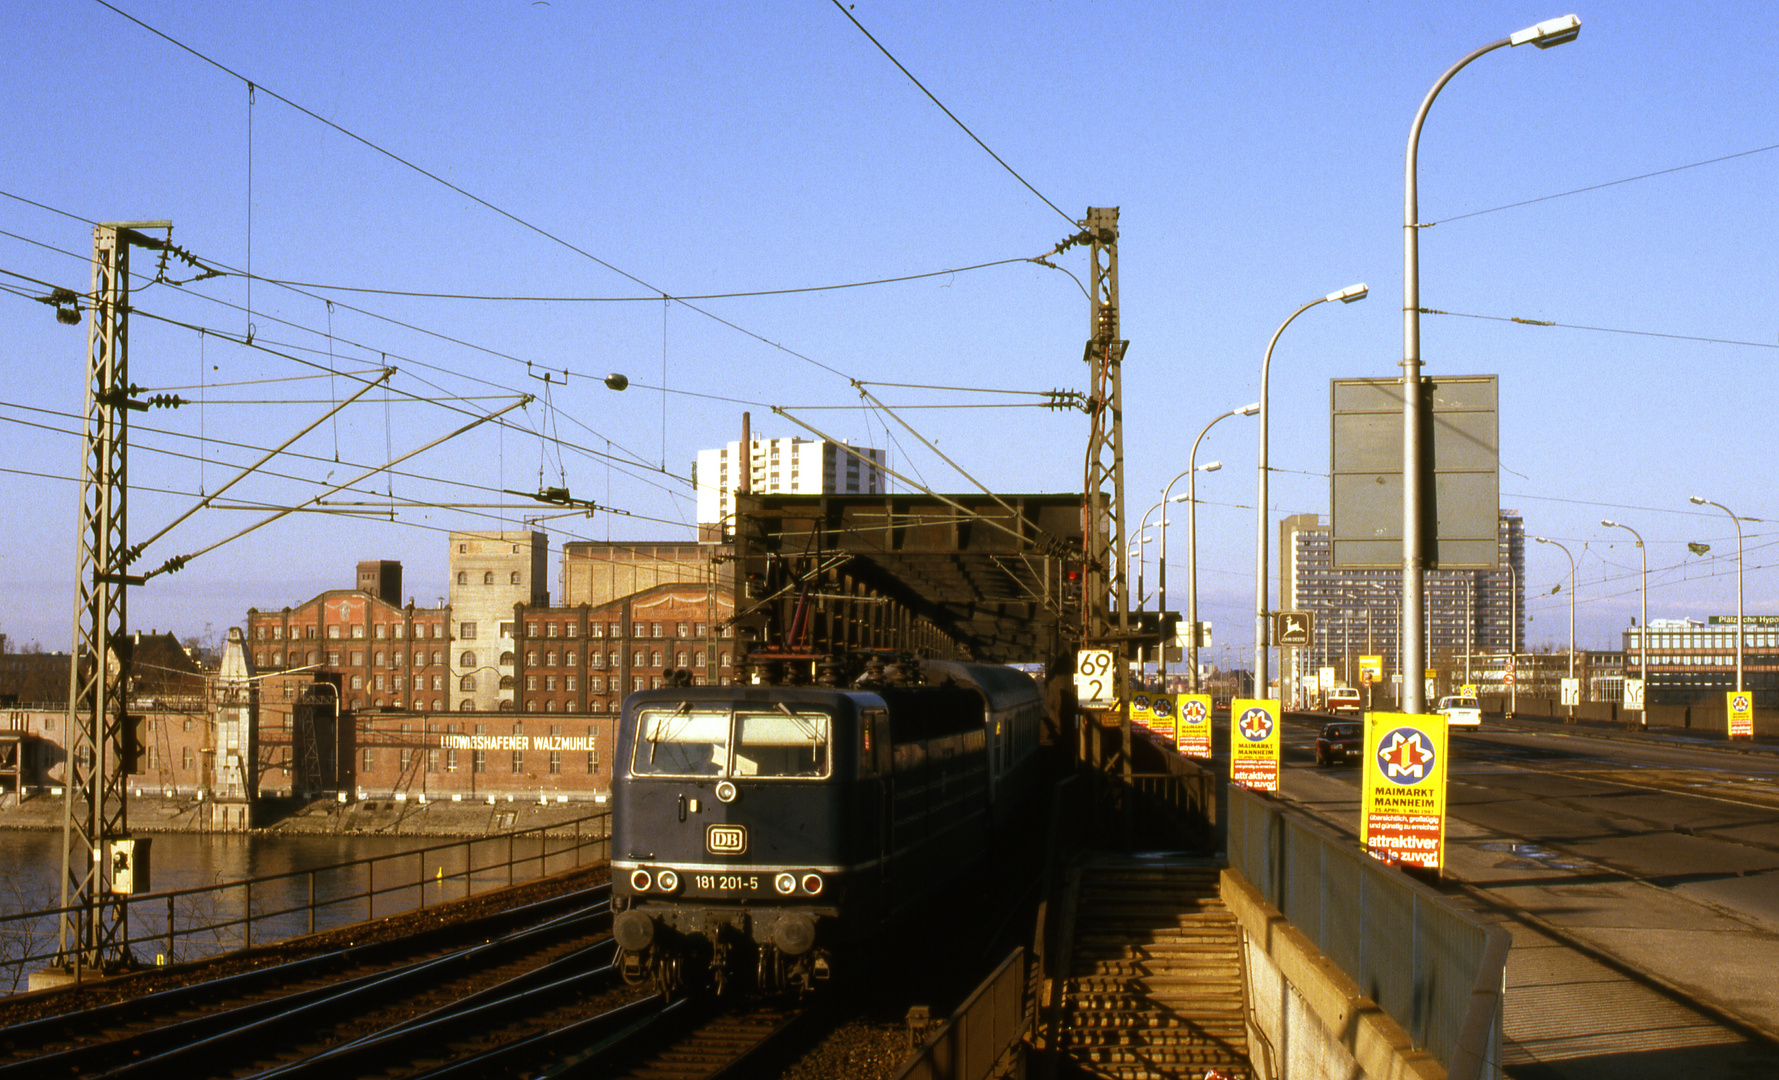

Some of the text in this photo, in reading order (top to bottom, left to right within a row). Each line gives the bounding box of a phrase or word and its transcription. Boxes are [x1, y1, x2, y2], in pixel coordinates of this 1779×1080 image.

[1080, 653, 1110, 676] 69
[1089, 679, 1103, 702] 2
[440, 735, 529, 750] LUDWIGSHAFENER
[1235, 772, 1276, 780] attraktiver
[1375, 787, 1435, 797] MAIMARKT
[1374, 797, 1435, 808] MANNHEIM
[1369, 815, 1409, 823] übersichtlich,
[1381, 822, 1403, 831] günstig
[1411, 823, 1439, 831] erreichen
[714, 832, 738, 846] DB
[1368, 835, 1438, 849] attraktiver
[1387, 849, 1399, 863] je
[1400, 851, 1438, 863] zuvor!
[695, 875, 759, 890] 181 201-5
